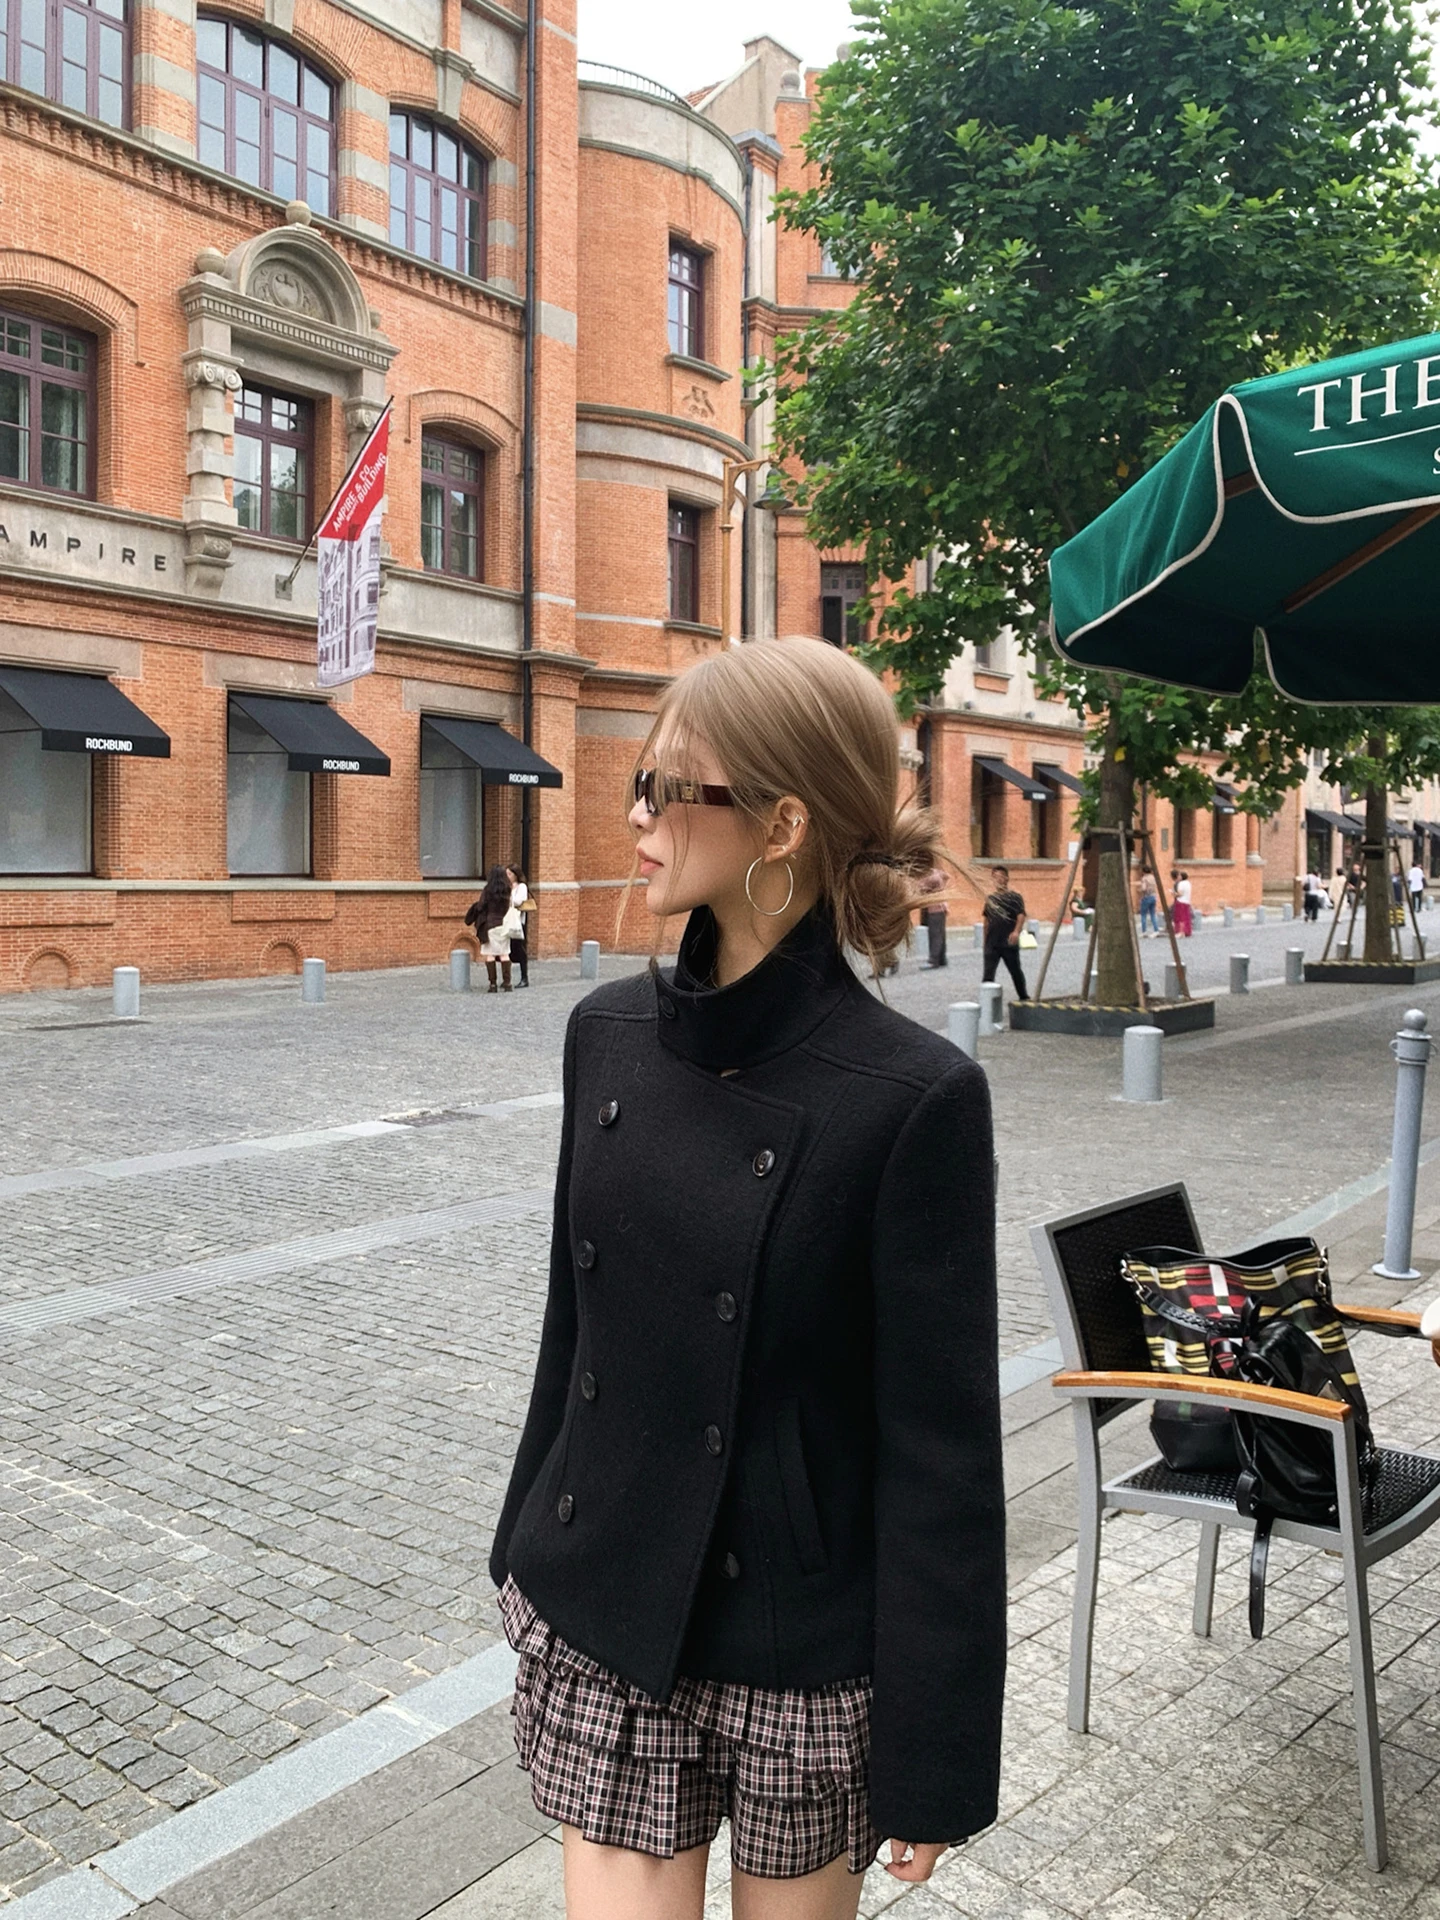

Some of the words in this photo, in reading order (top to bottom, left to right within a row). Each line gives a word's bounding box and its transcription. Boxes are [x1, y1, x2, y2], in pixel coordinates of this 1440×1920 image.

[1297, 354, 1440, 432] THE
[357, 452, 387, 504] BUILDING
[332, 491, 357, 532] AMPIRE
[355, 482, 363, 493] &
[0, 524, 167, 571] AMPIRE
[85, 737, 133, 752] ROCKBUND
[322, 759, 360, 771] ROCKBUND
